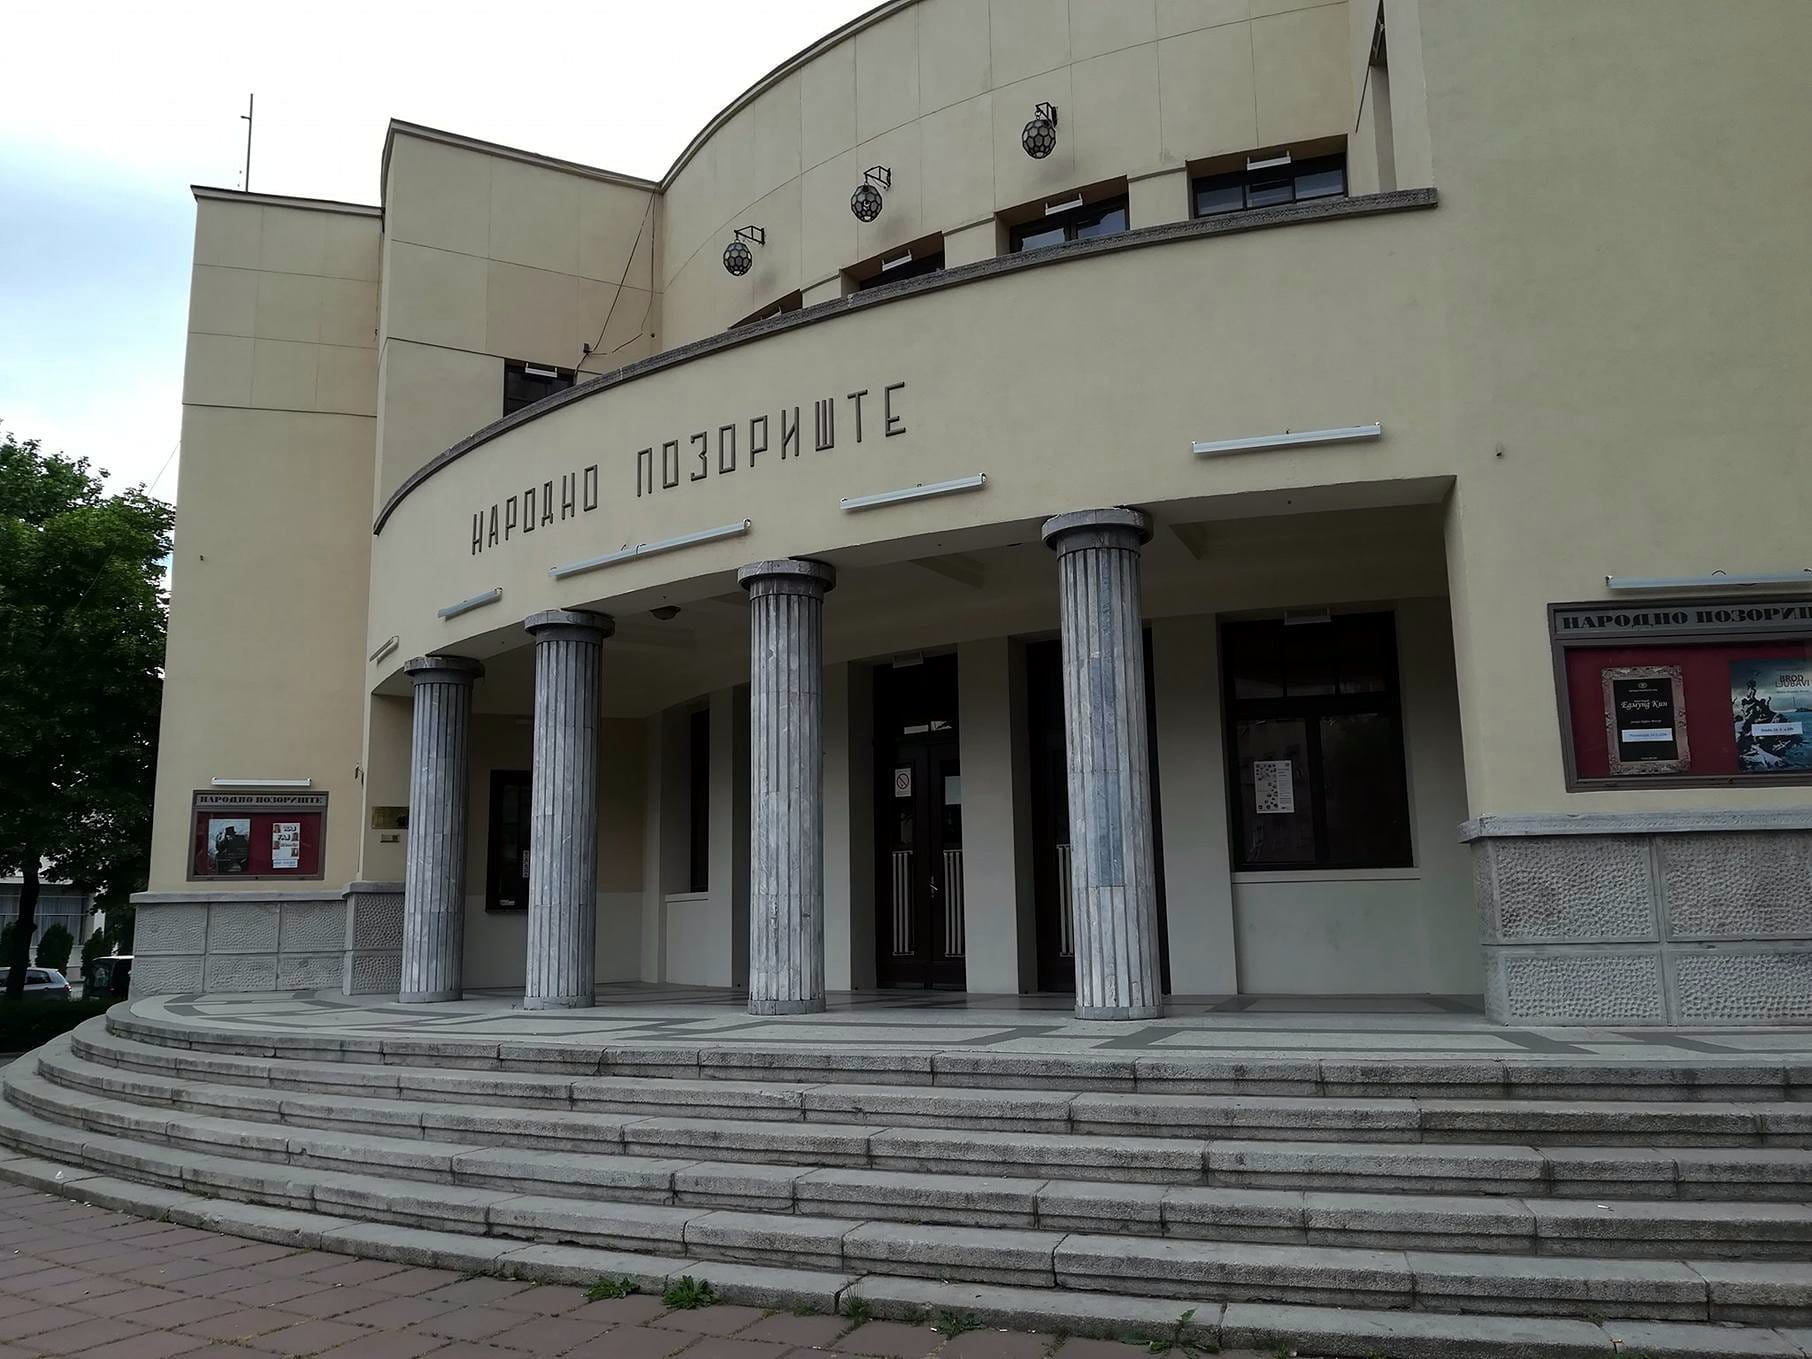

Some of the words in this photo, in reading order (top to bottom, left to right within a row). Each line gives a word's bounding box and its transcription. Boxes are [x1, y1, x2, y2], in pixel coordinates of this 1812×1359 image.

[472, 464, 598, 555] НАРОДНО
[636, 381, 906, 497] ПОЗОРИШТЕ
[1562, 611, 1689, 629] НАРОДНО
[1779, 674, 1804, 682] BROD
[200, 796, 253, 804] НАРОДНО
